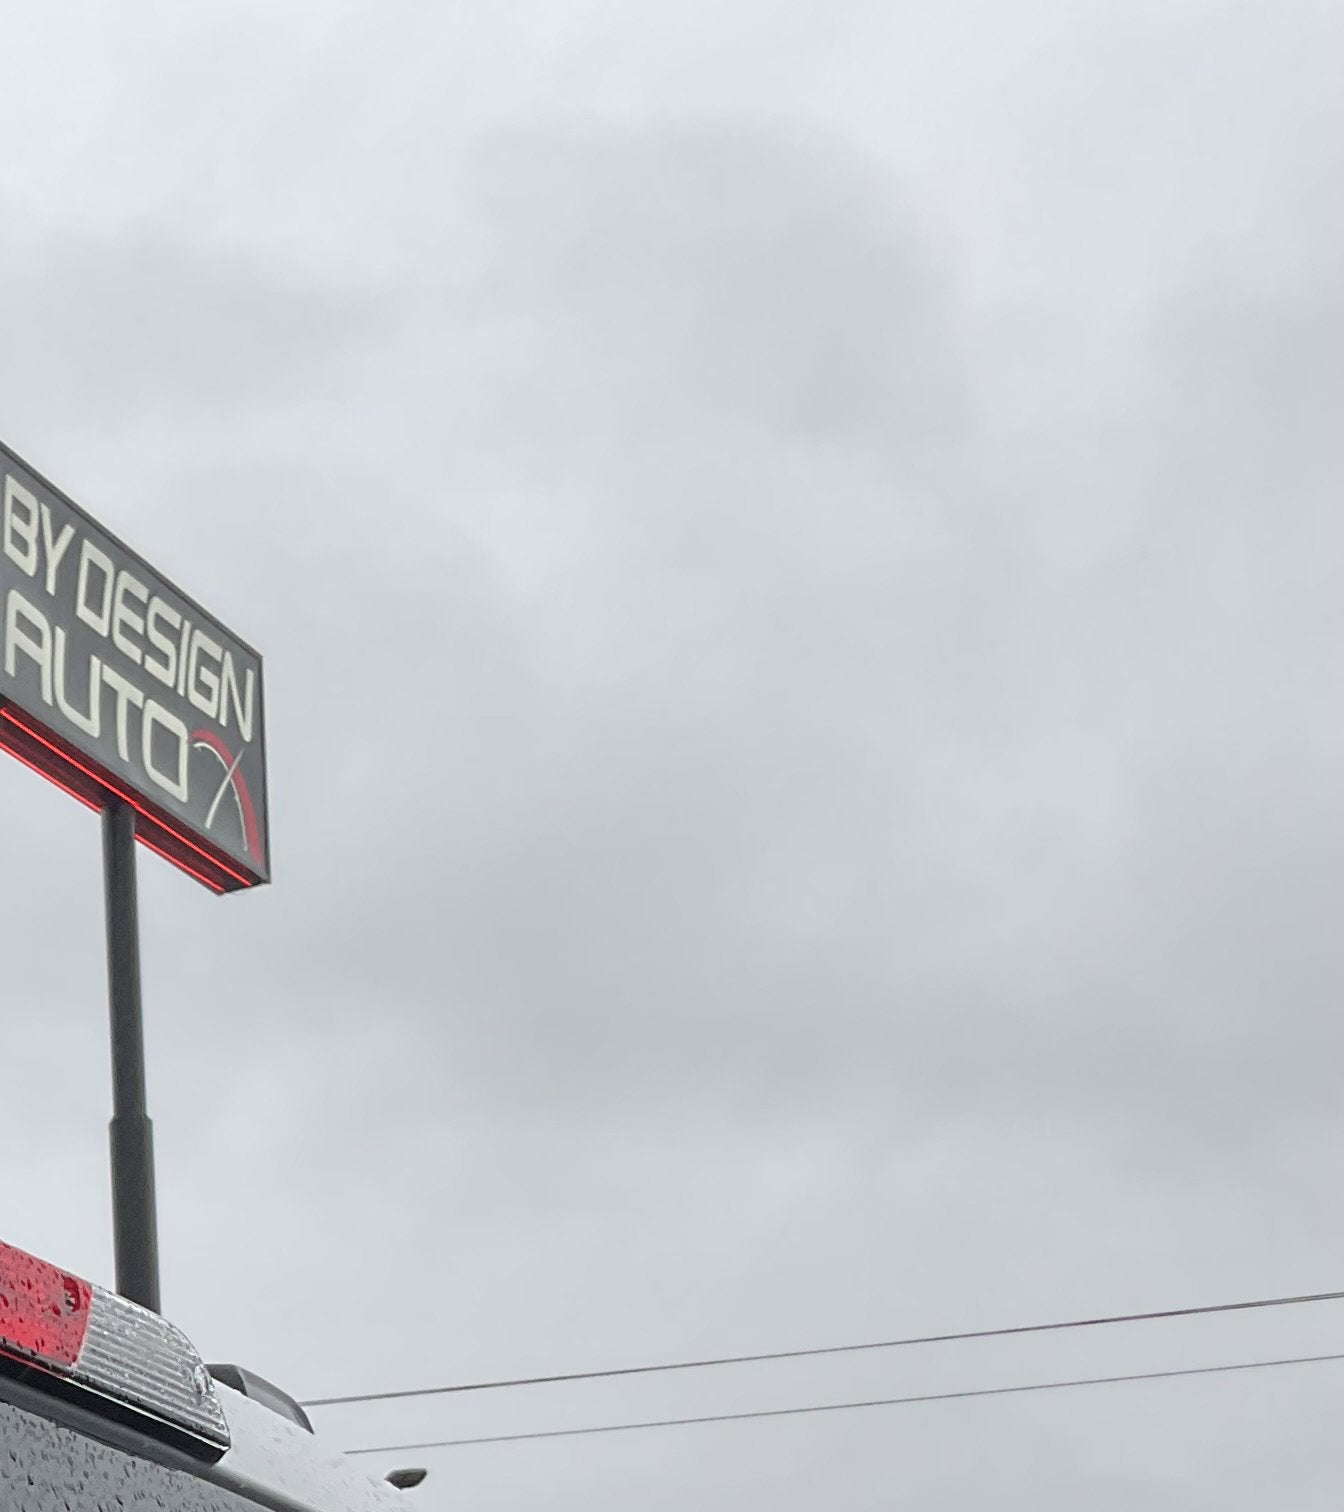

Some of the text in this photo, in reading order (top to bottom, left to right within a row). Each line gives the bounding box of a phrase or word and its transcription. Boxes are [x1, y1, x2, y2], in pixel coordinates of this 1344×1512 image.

[3, 474, 253, 742] BY DESIGN
[4, 589, 189, 803] AUTO
